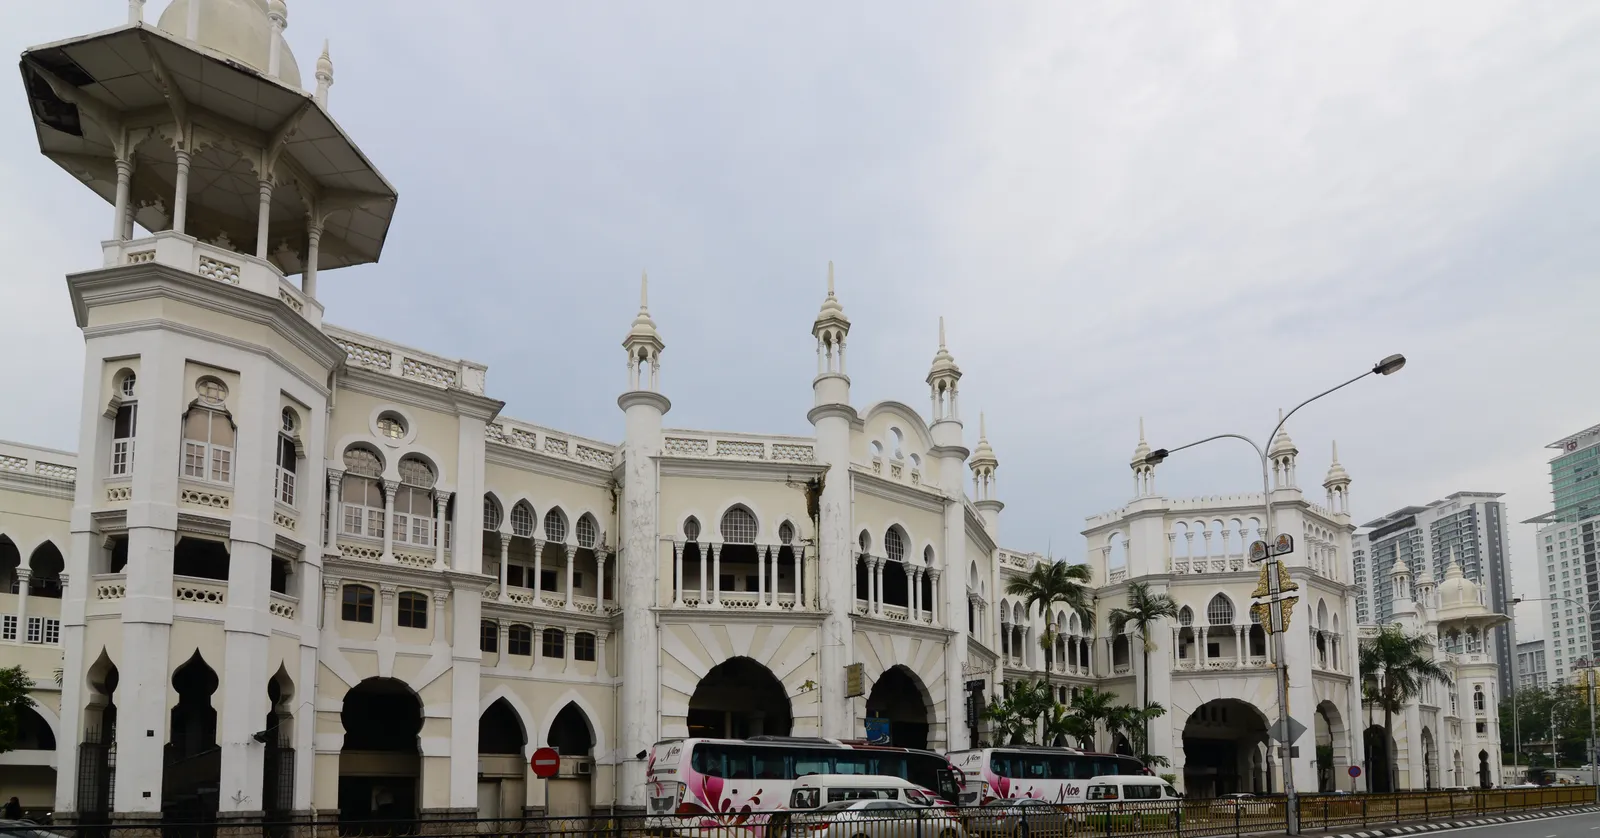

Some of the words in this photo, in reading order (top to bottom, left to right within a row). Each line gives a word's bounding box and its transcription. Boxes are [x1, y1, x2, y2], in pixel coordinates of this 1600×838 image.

[660, 746, 680, 762] Nice
[960, 754, 981, 767] Nice
[1049, 783, 1080, 804] Nice
